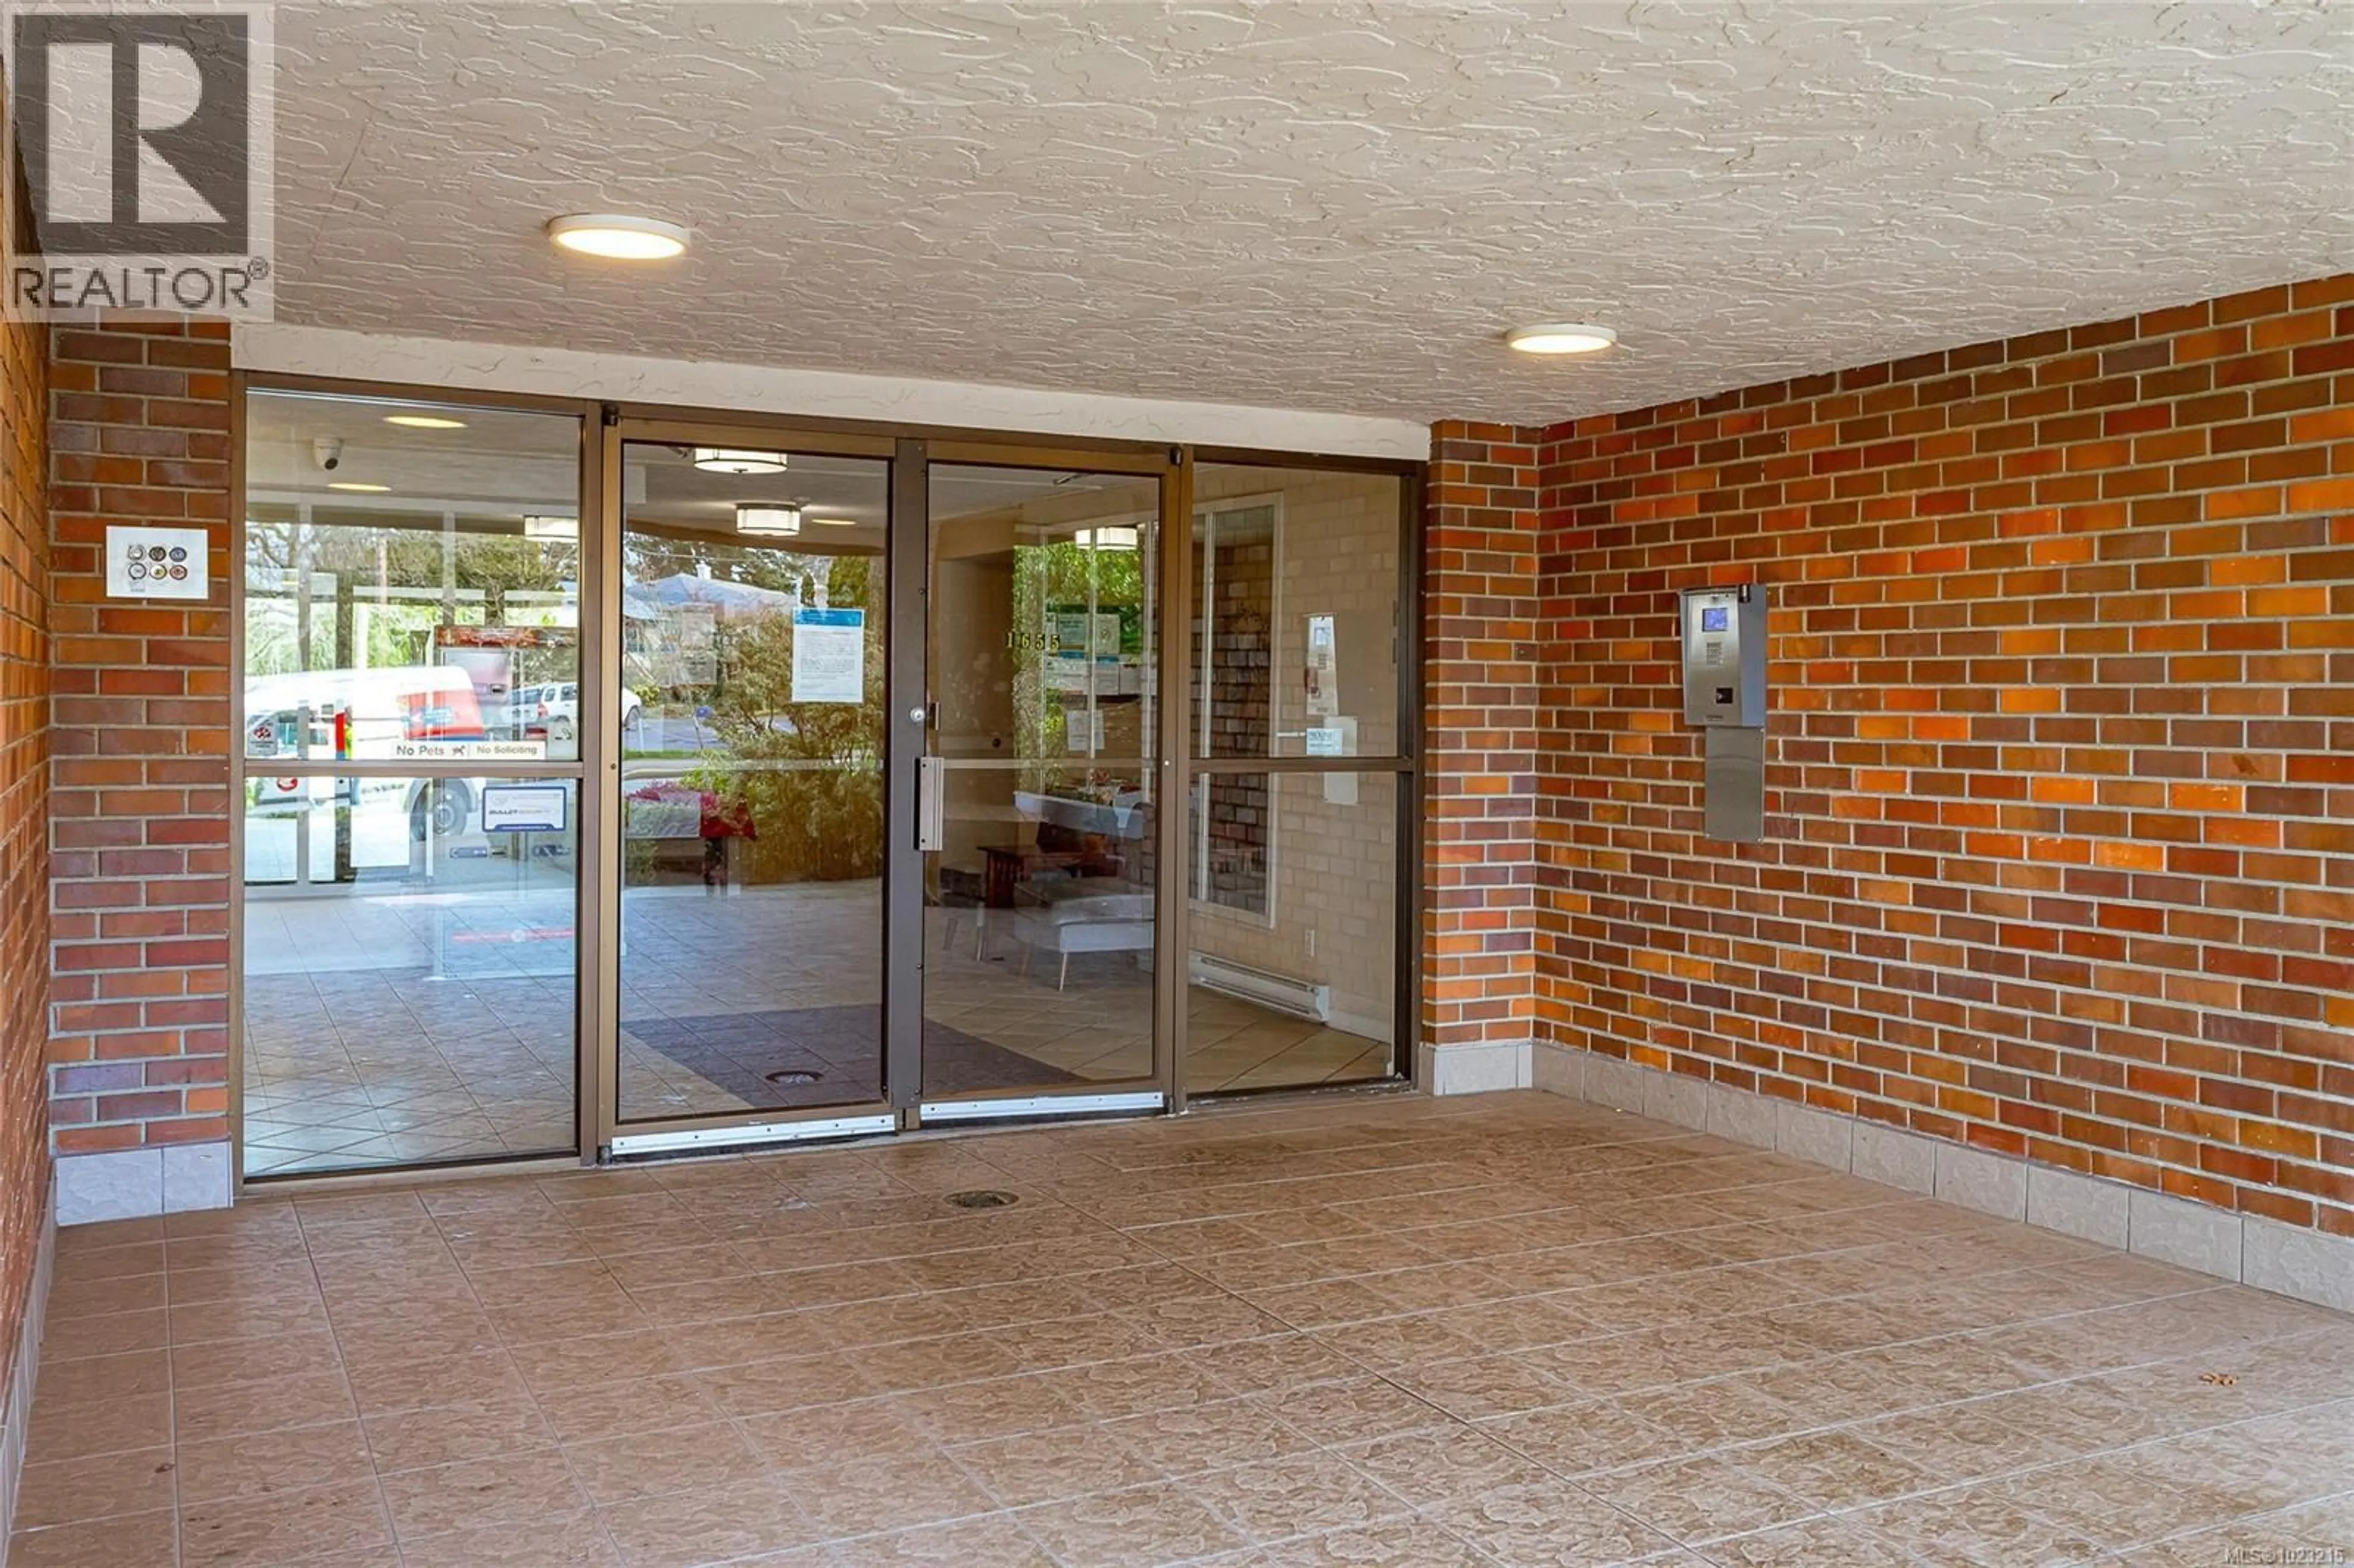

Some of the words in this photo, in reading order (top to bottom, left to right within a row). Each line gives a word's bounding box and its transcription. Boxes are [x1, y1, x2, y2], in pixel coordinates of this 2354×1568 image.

[1007, 631, 1059, 653] 1655
[397, 745, 414, 756] No
[419, 745, 444, 756] Pets
[477, 746, 490, 755] No
